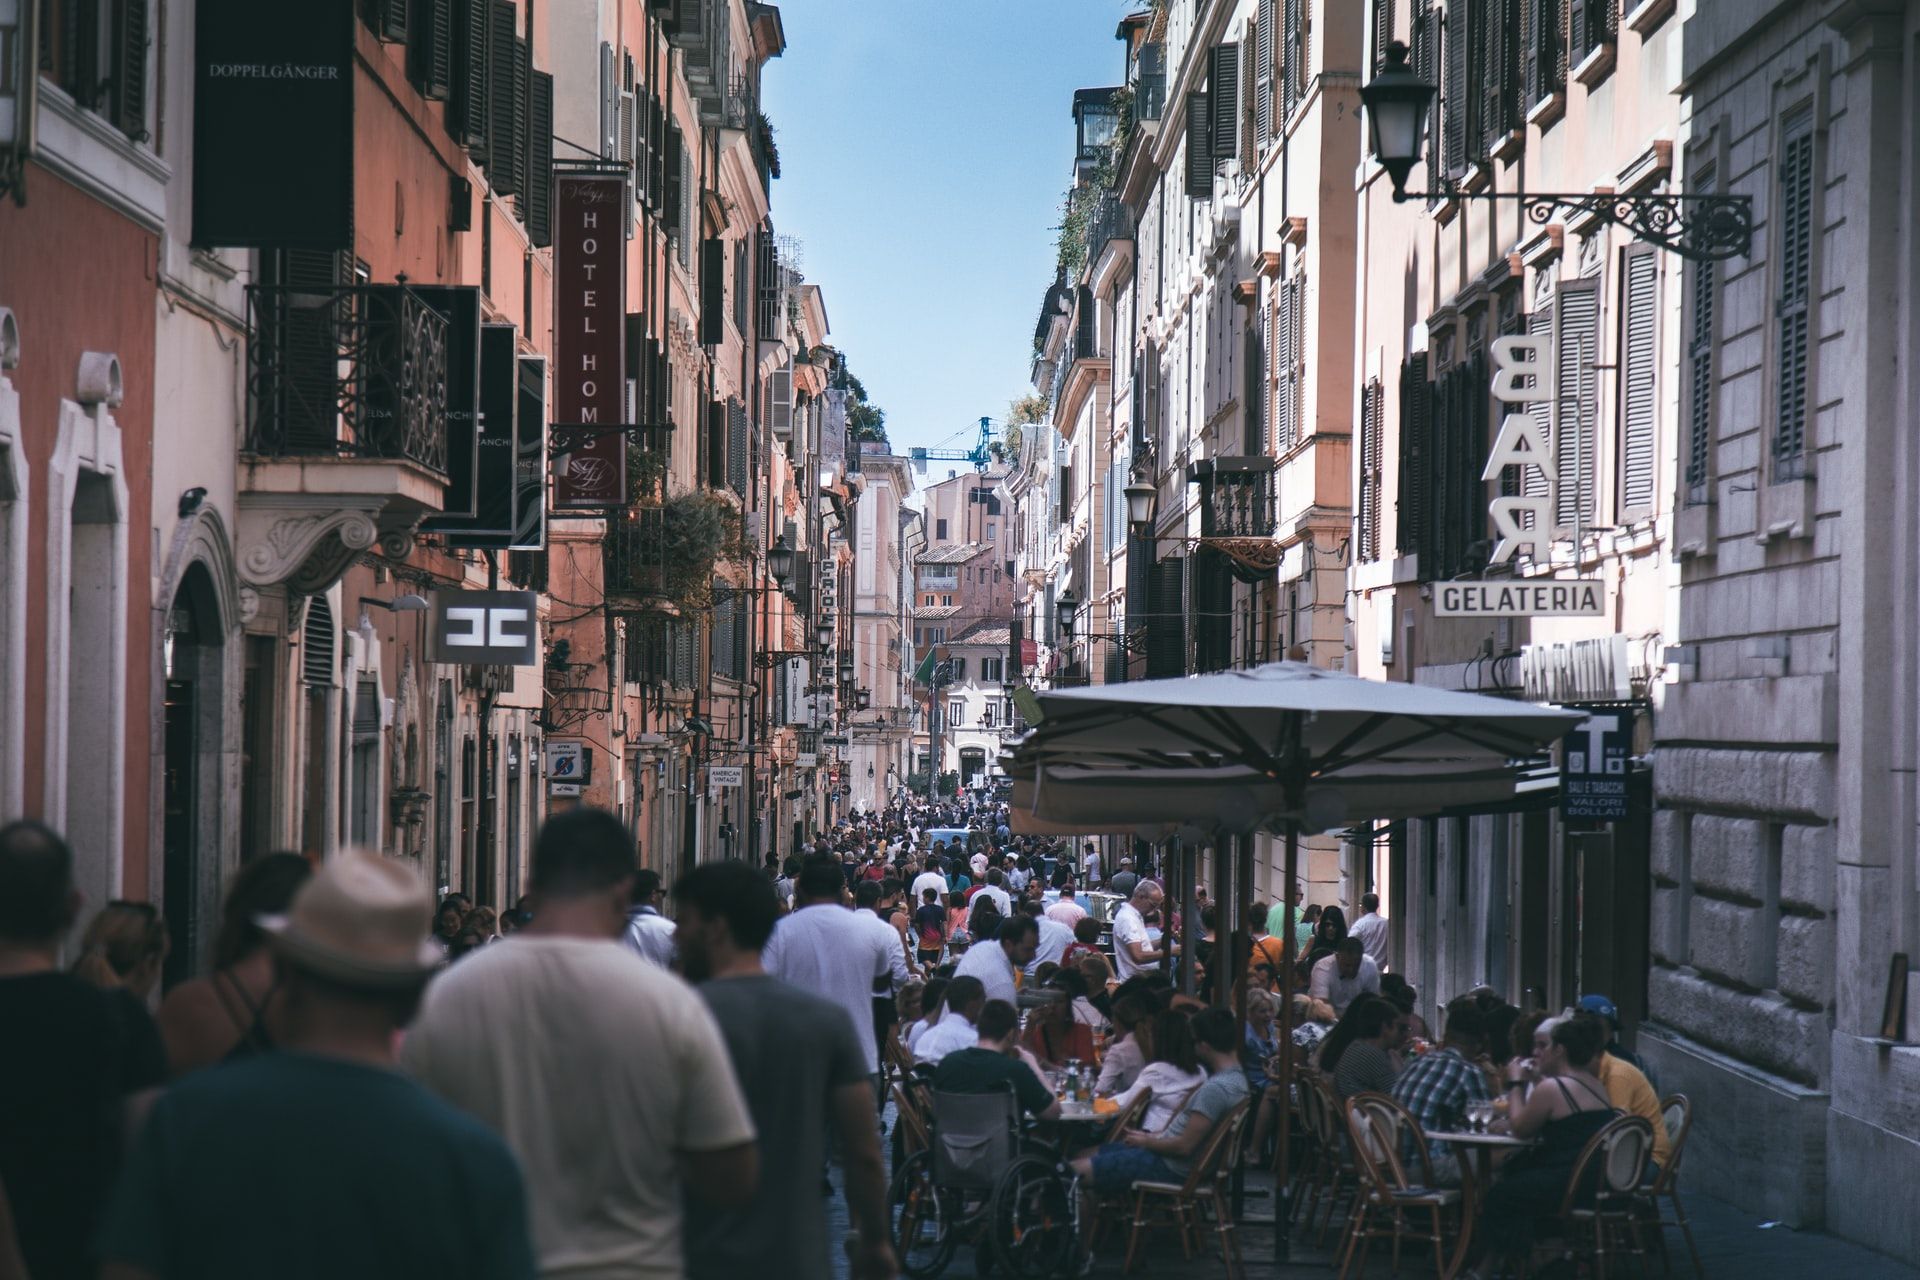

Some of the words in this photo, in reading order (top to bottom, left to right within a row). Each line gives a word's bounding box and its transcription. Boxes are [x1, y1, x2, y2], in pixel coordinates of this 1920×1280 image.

[209, 62, 338, 79] DOPPELGÄNGER
[582, 211, 598, 334] HOTEL
[1443, 587, 1597, 612] GELATERIA
[820, 559, 836, 729] PROFMERIA
[1567, 807, 1627, 816] BOLLATI
[1571, 798, 1623, 807] VALORI
